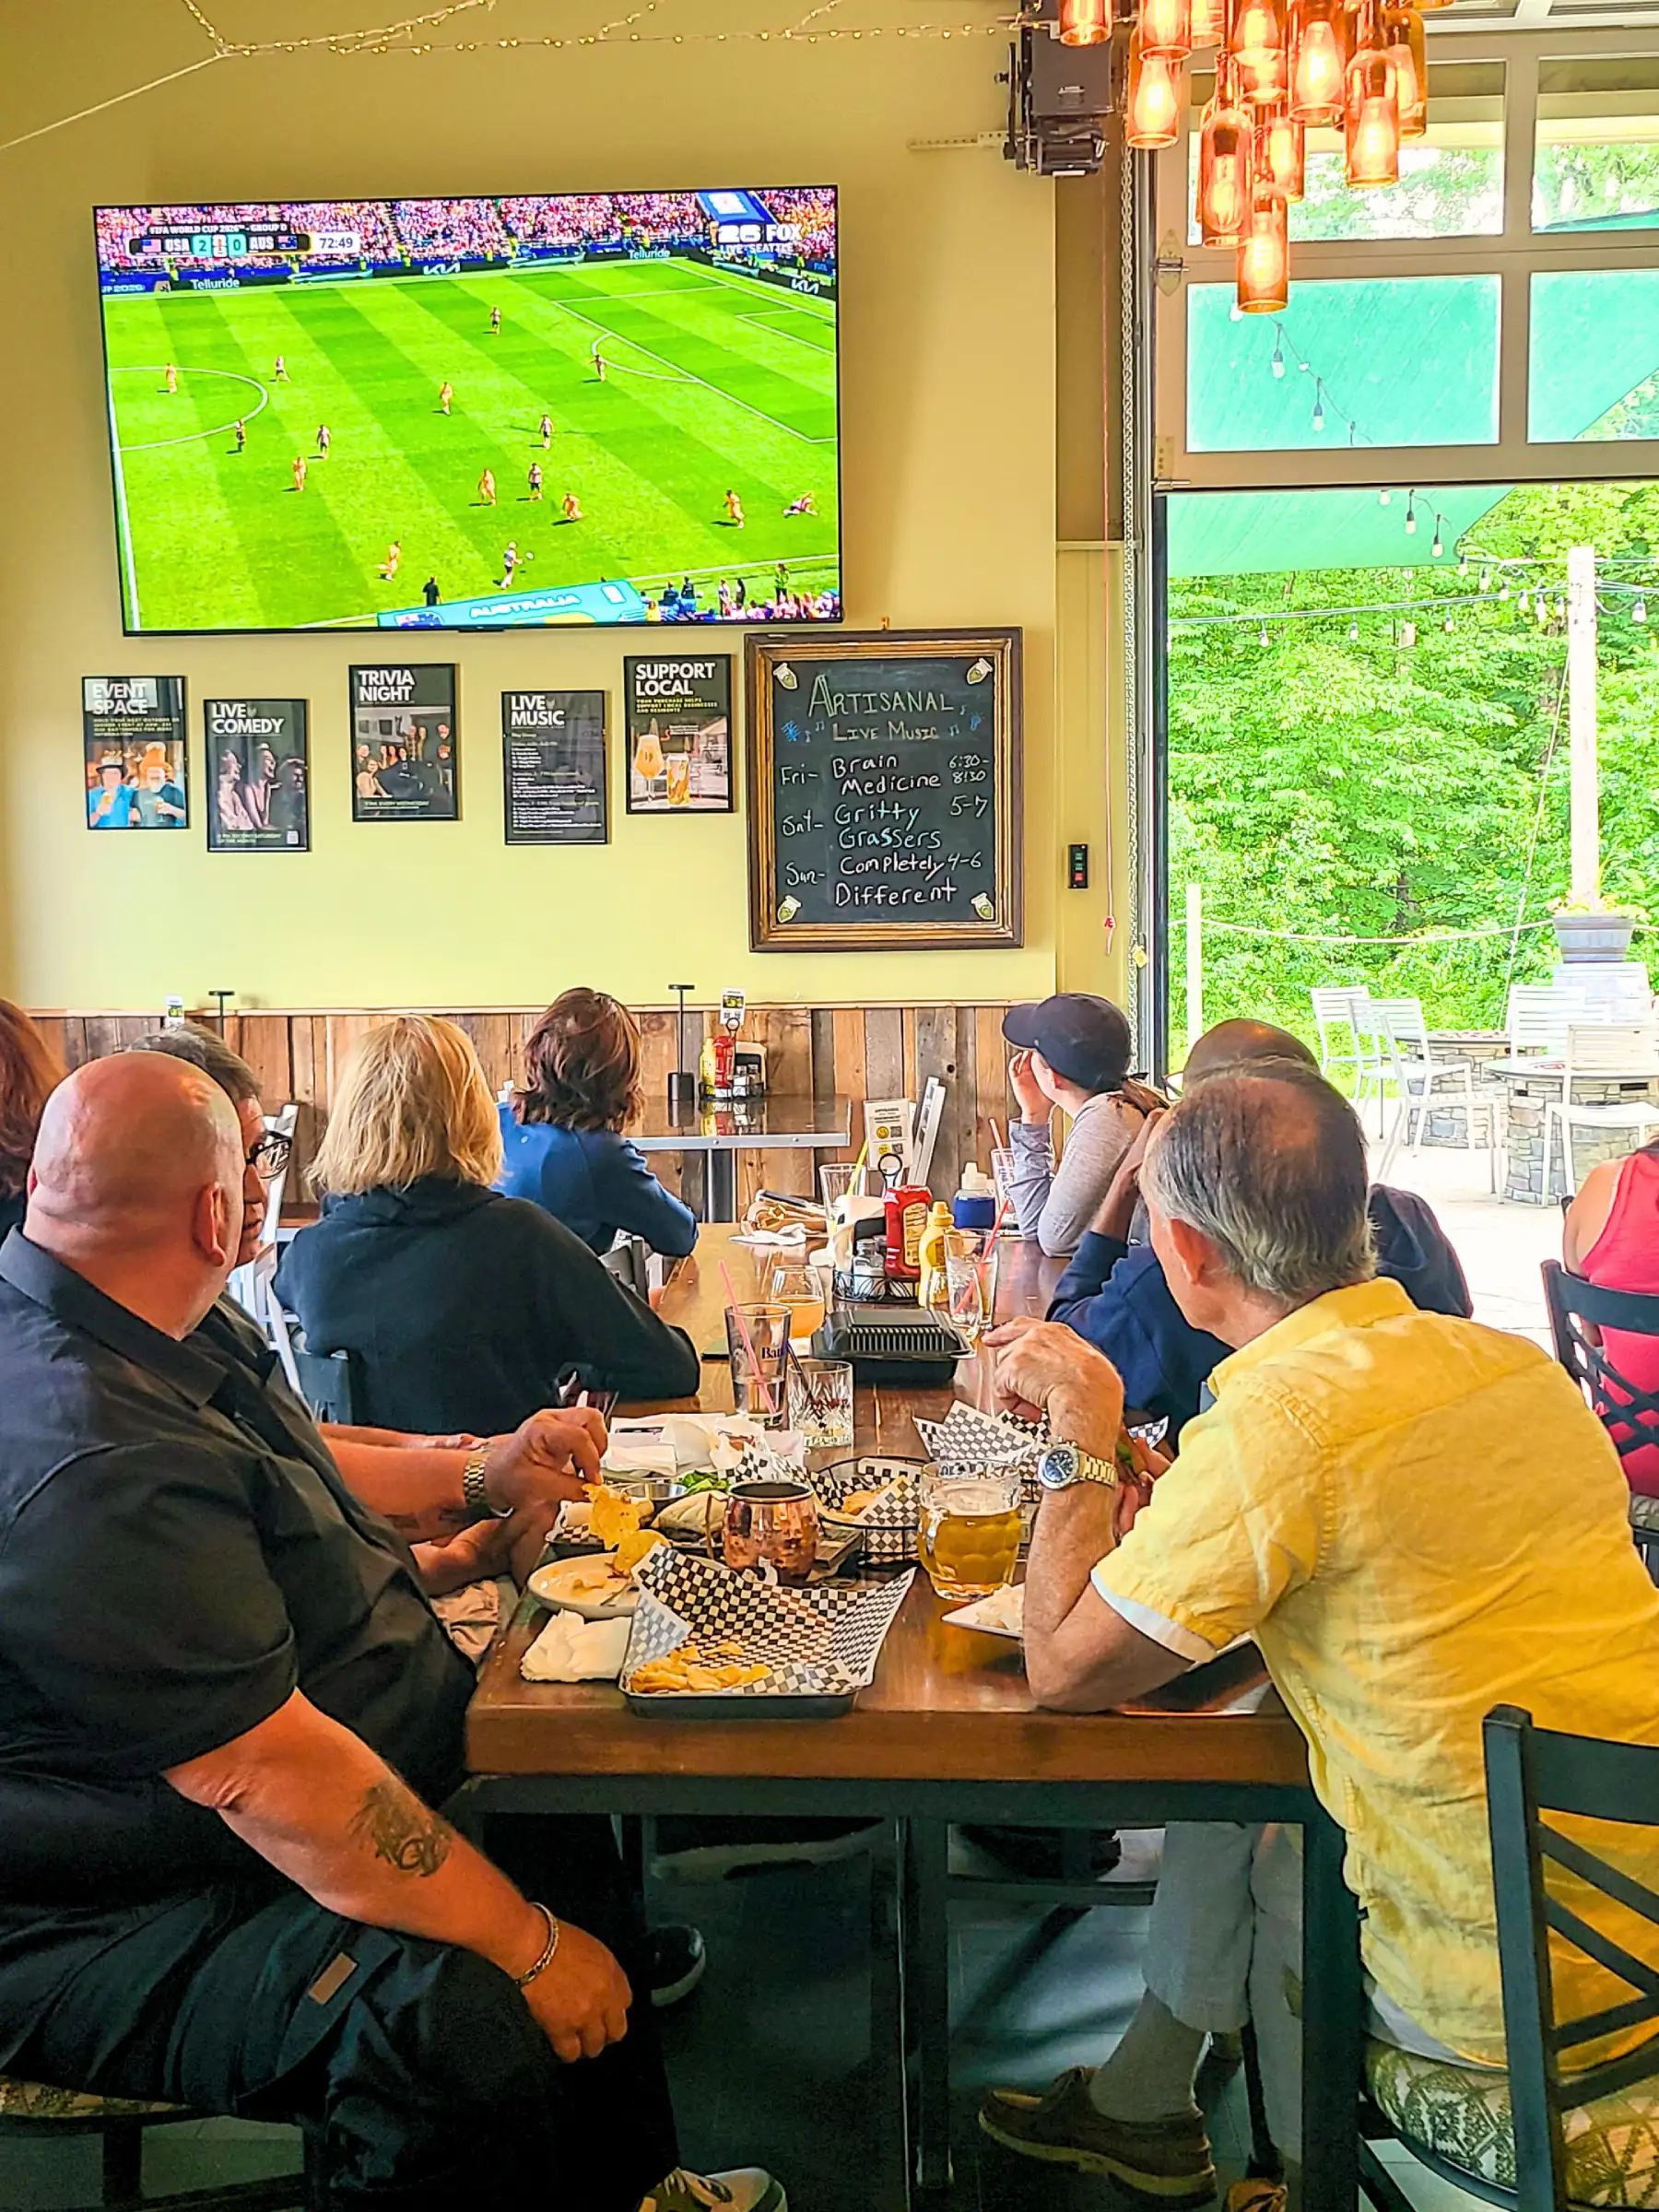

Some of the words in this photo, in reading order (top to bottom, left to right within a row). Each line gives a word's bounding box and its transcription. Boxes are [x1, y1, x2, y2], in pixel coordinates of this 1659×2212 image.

[150, 226, 169, 234] FIFA
[171, 225, 201, 234] WORLD
[202, 225, 218, 233] CUP
[251, 224, 278, 232] GROUP
[718, 225, 761, 243] 26
[766, 224, 804, 241] FOX
[164, 238, 191, 253] USA
[199, 240, 207, 253] 2
[233, 239, 241, 251] 0
[249, 236, 275, 251] AUS
[319, 237, 354, 251] 72:49
[720, 244, 744, 254] LIVE
[747, 243, 794, 253] SEATTLE
[628, 247, 671, 260] Telluride
[190, 277, 241, 290] Telluride
[470, 594, 582, 618] AUSTRALIA
[359, 670, 416, 687] TRIVIA
[635, 663, 716, 680] SUPPORT
[94, 683, 147, 700] EVENT
[359, 686, 413, 702] NIGHT
[636, 679, 694, 697] LOCAL
[808, 674, 954, 718] ARTISANAL
[94, 700, 148, 716] SPACE
[212, 703, 247, 718] LIVE
[512, 696, 547, 711] LIVE
[212, 718, 285, 734] COMEDY
[512, 711, 565, 726] MUSIC
[832, 723, 878, 742] LIVE
[888, 721, 940, 741] MUSIC
[832, 755, 899, 779] Brain
[841, 774, 942, 797] Medicine
[952, 770, 987, 784] 8:30
[834, 800, 920, 832] Gritty
[949, 794, 989, 818] 5-7
[839, 828, 942, 849] Grassers
[840, 855, 945, 882] Completely
[947, 851, 982, 873] 4-6
[835, 877, 959, 908] Different
